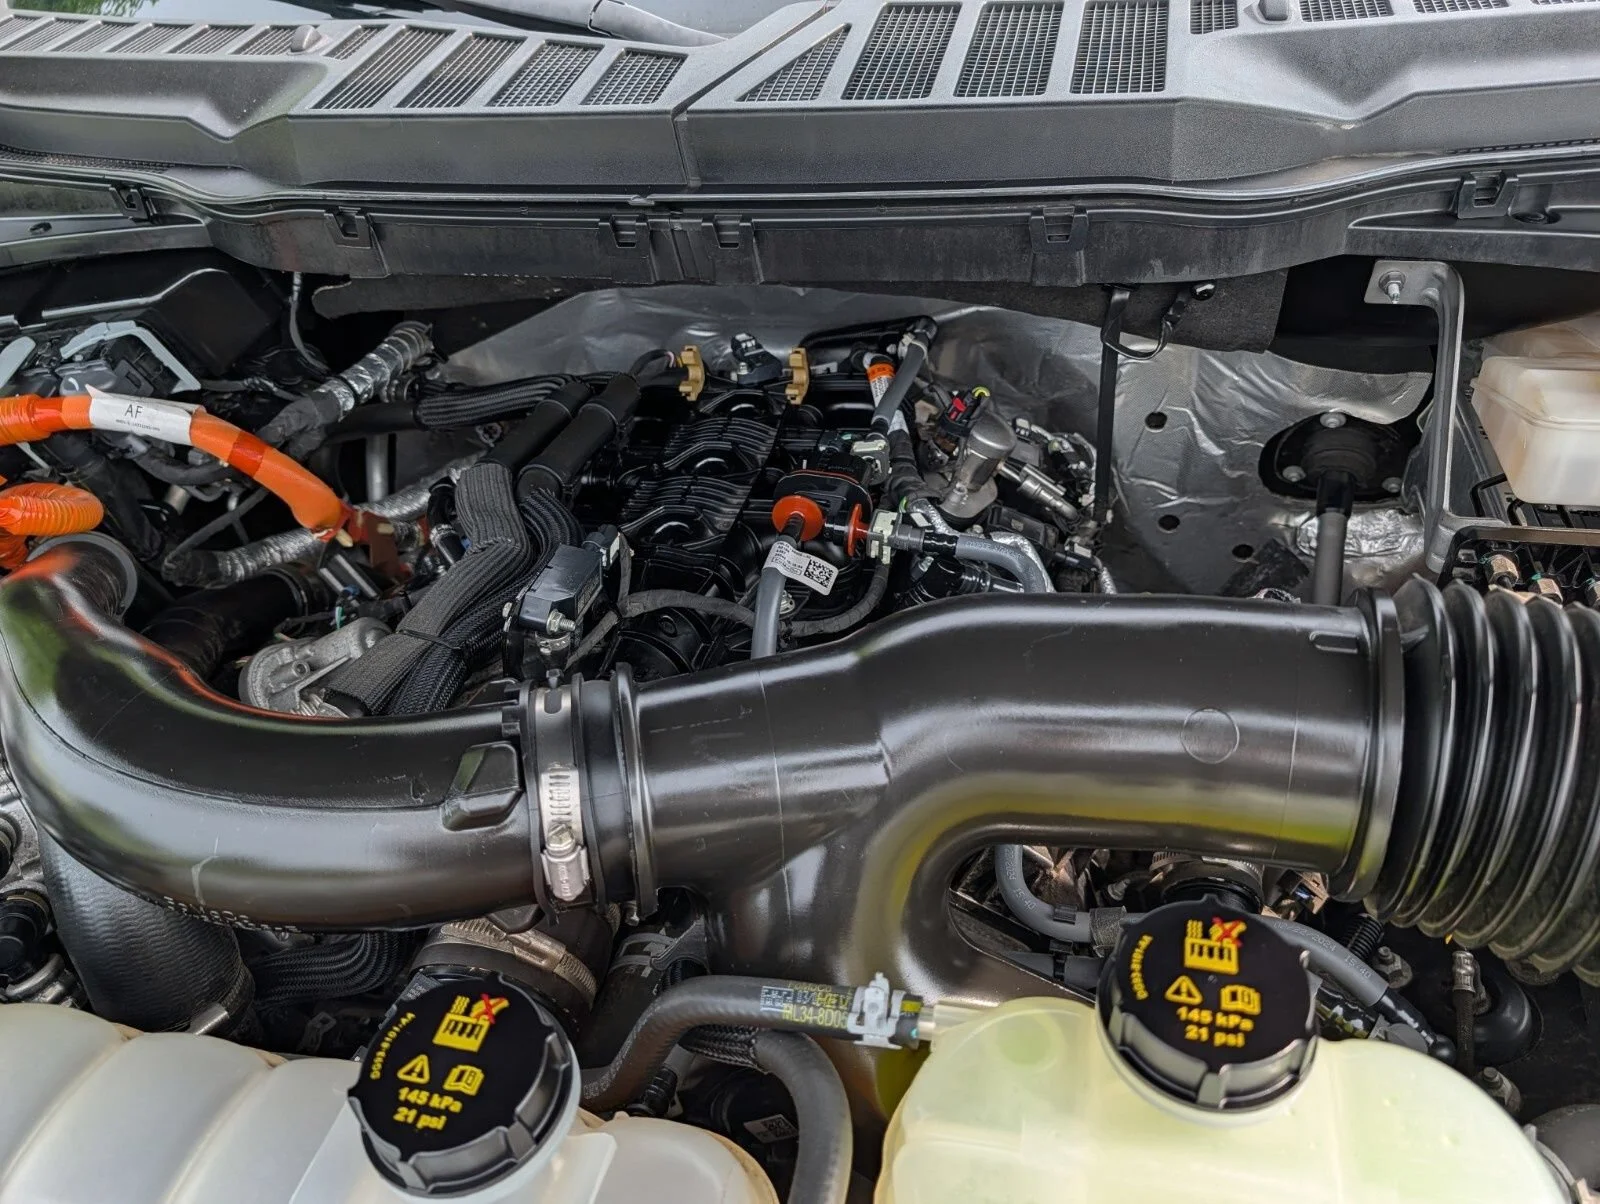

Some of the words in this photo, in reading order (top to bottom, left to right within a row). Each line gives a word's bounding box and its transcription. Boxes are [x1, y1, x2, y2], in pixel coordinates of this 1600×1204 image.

[124, 404, 143, 419] AF
[1176, 1006, 1213, 1025] 145
[1215, 1012, 1254, 1032] kPa
[1184, 1024, 1209, 1043] 21
[1213, 1031, 1245, 1048] psi
[398, 1086, 430, 1105] 145
[429, 1093, 463, 1113] kPa
[392, 1106, 417, 1124] 21
[416, 1114, 447, 1130] psi
